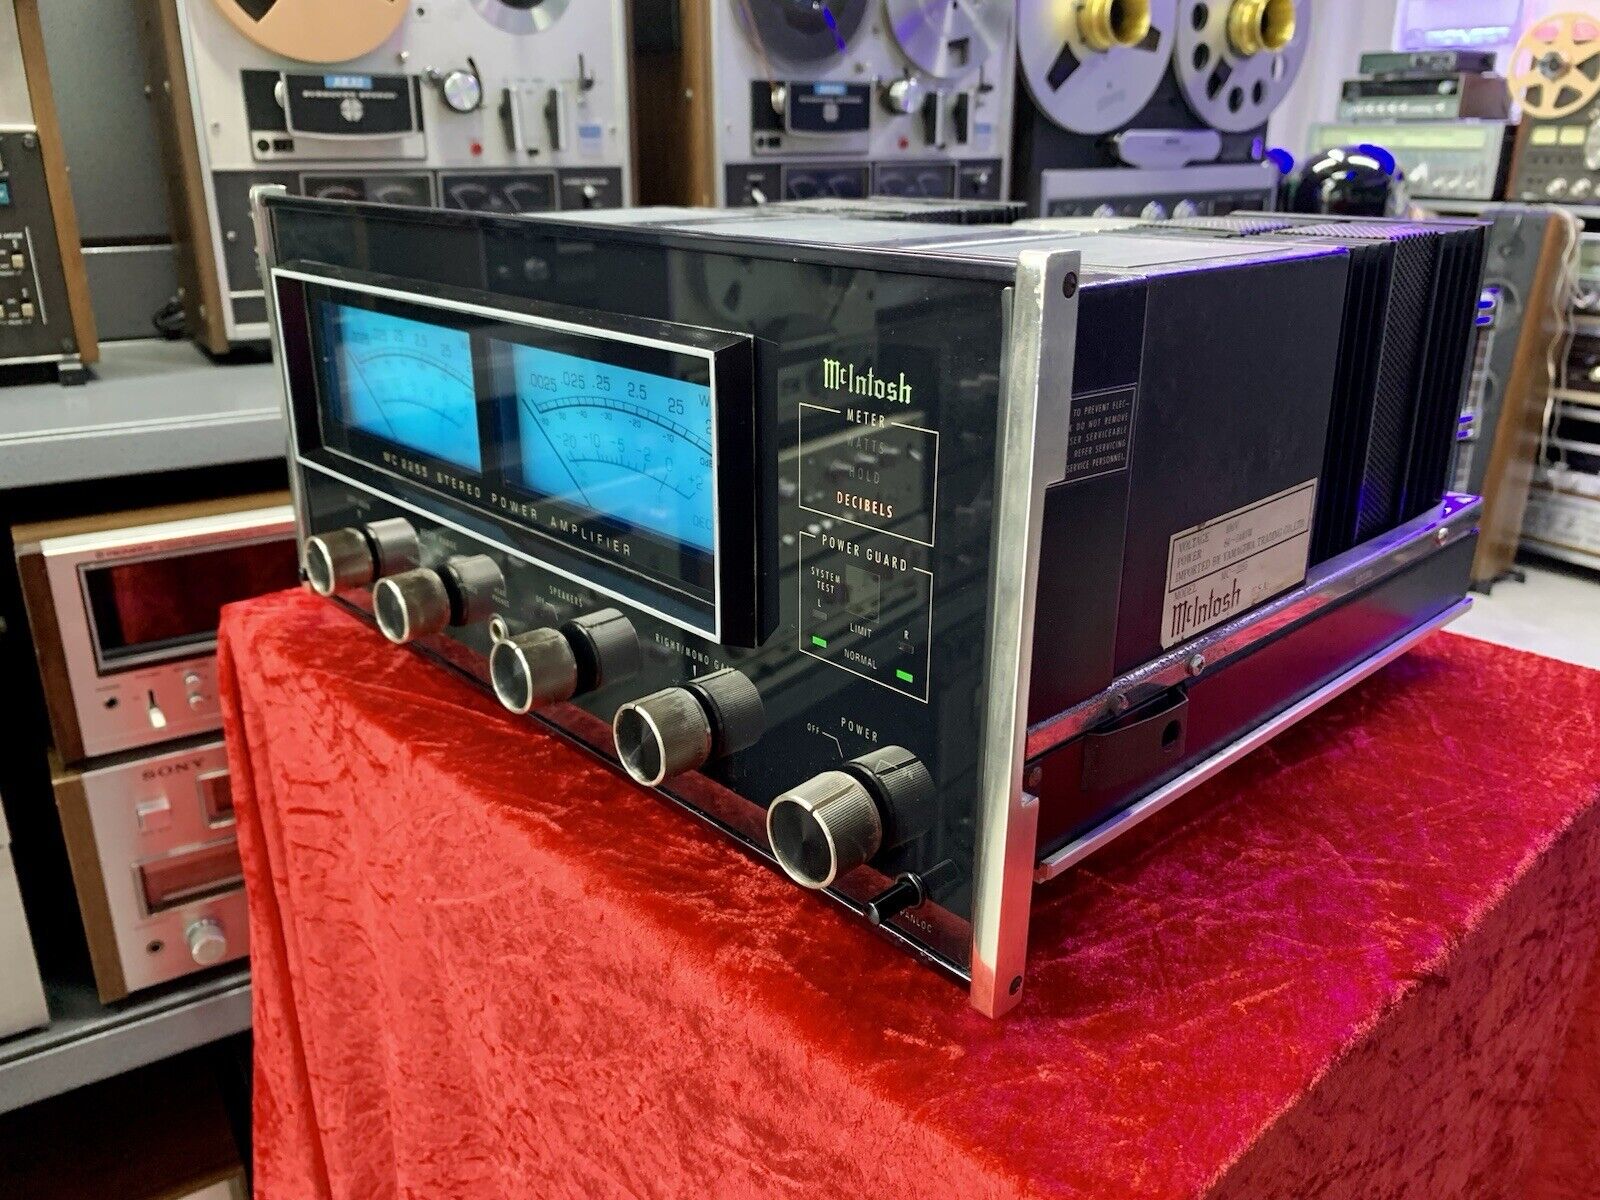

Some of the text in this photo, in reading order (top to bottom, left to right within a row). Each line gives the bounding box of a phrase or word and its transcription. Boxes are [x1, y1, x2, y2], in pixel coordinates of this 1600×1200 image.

[823, 357, 912, 405] McIntosh
[627, 381, 648, 400] 2.5
[667, 397, 684, 416] 25
[847, 408, 885, 428] METER
[849, 465, 881, 485] HOLD
[436, 471, 481, 500] STEREO
[491, 492, 538, 521] POWER
[549, 515, 632, 557] AMPLIFIER
[836, 490, 893, 519] DECIBELS
[822, 534, 908, 572] POWER GUARD
[811, 566, 841, 584] SYSTEM
[816, 580, 835, 594] TEST
[817, 598, 822, 609] L
[1170, 577, 1242, 638] McIntosh
[849, 623, 873, 639] LIMIT
[904, 630, 910, 641] R
[844, 648, 878, 670] NORMAL
[806, 722, 820, 735] OFF
[840, 716, 878, 743] POWER
[142, 757, 204, 781] SONY
